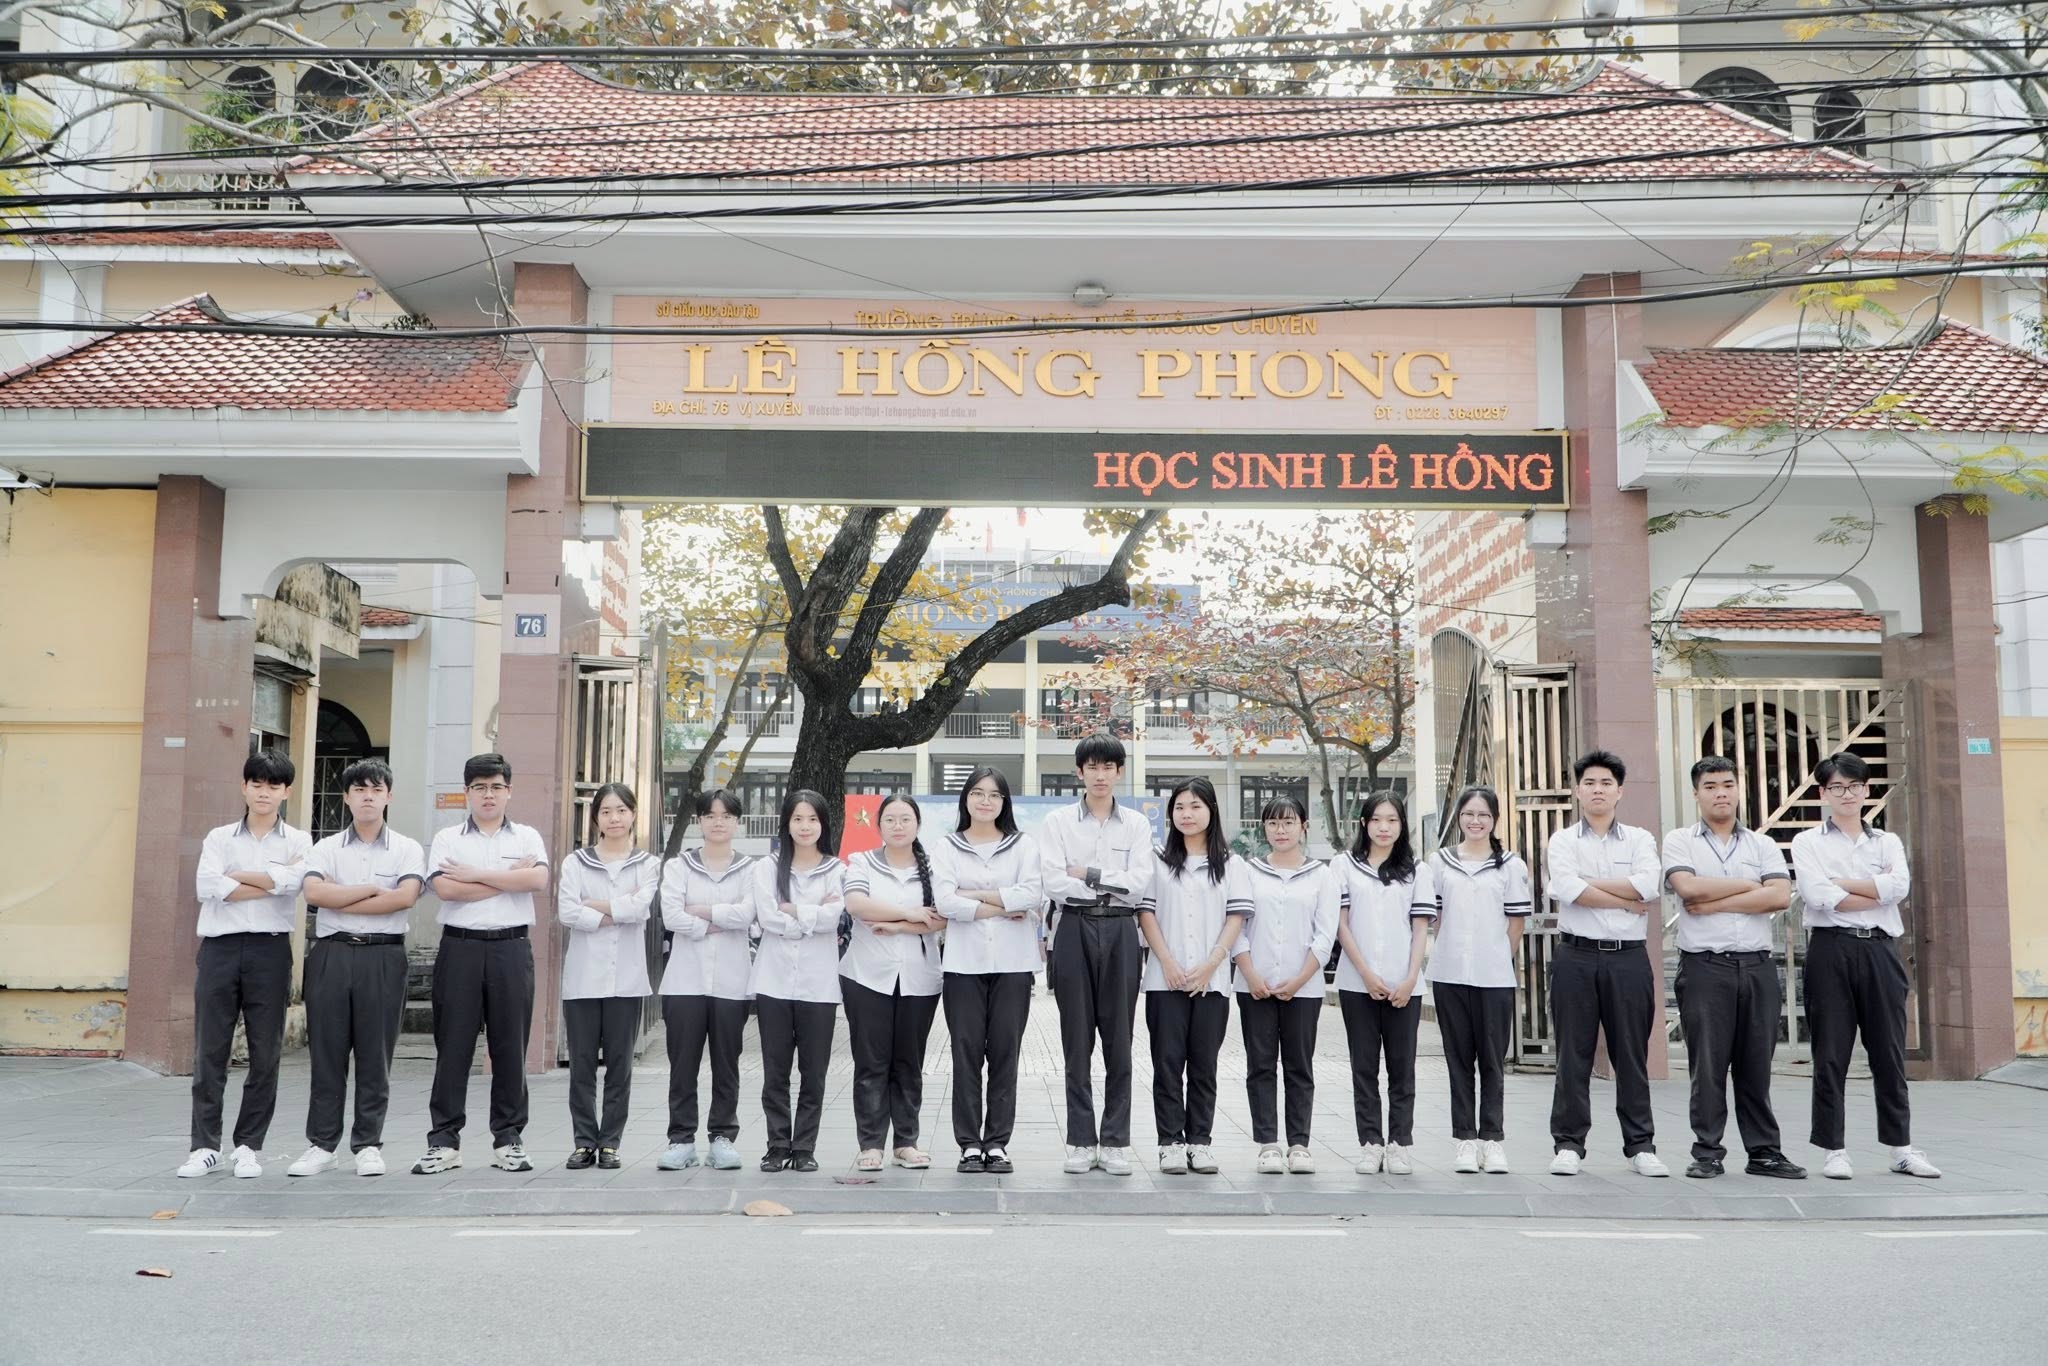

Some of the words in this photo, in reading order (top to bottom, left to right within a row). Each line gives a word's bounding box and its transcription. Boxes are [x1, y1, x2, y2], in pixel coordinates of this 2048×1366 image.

[1232, 313, 1319, 335] CHUYÊN
[683, 336, 798, 395] LÊ
[837, 337, 1102, 397] HỒNG
[1137, 348, 1459, 399] PHONG
[712, 401, 729, 415] 76
[756, 399, 803, 416] XUYÊN
[808, 404, 842, 416] Website:
[1094, 451, 1199, 496] HỌC
[1211, 451, 1326, 490] SINH
[1337, 443, 1399, 490] LÊ
[1410, 442, 1554, 491] HỒNG
[521, 618, 542, 635] 76
